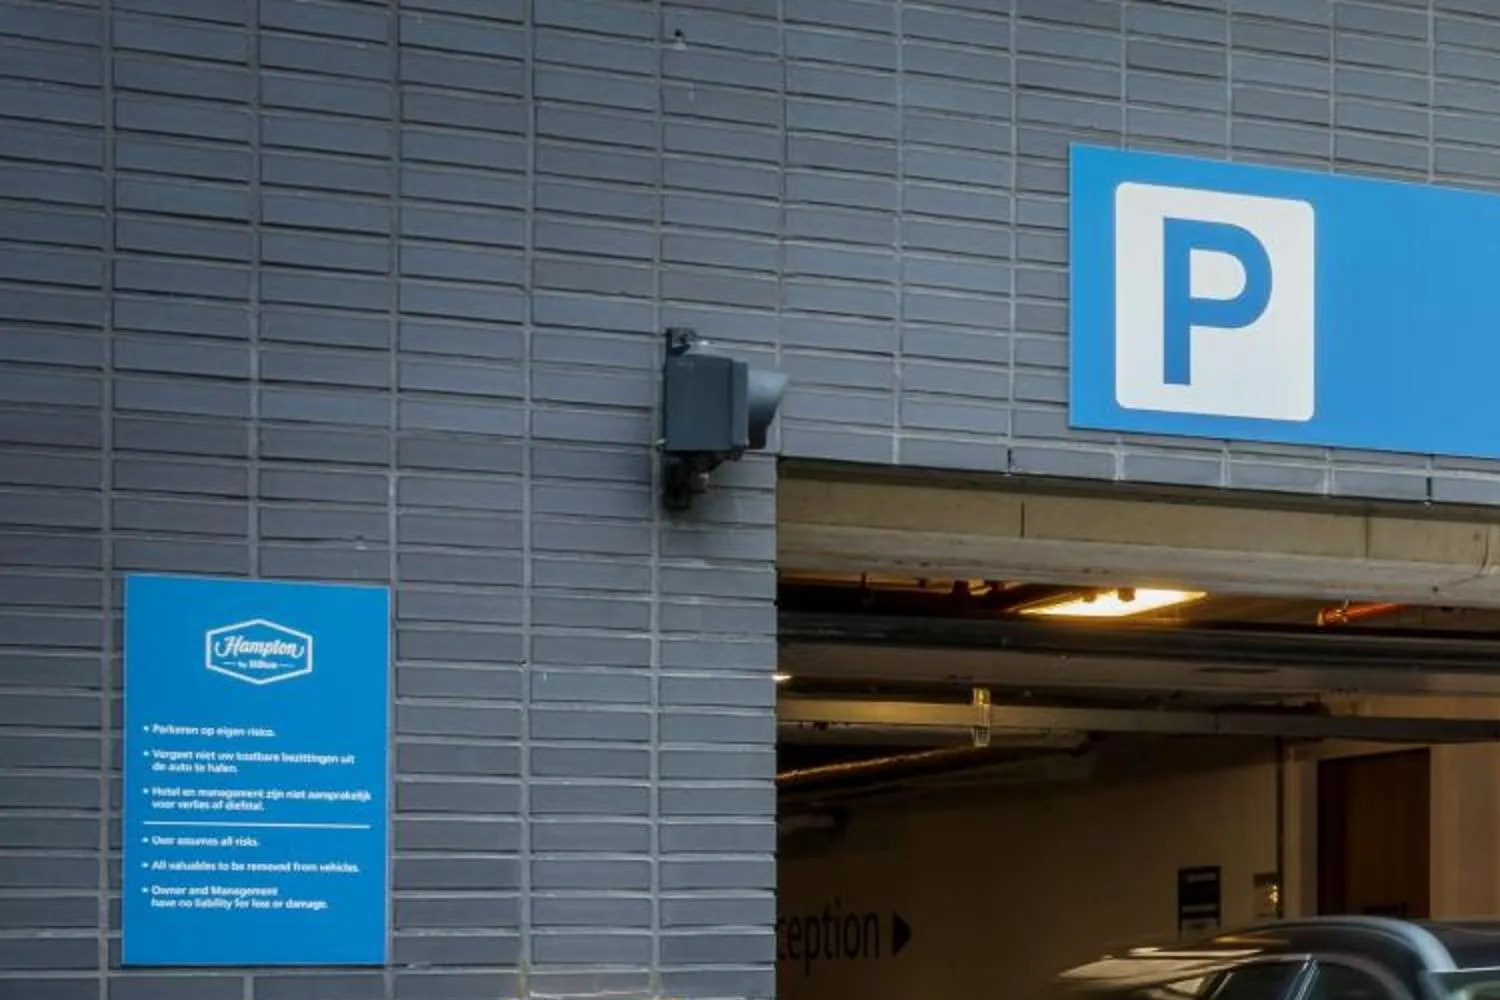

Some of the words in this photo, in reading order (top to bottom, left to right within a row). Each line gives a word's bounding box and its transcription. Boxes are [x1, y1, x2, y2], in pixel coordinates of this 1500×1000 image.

[1163, 216, 1273, 385] P
[215, 635, 305, 659] Hampton
[152, 723, 198, 735] Parkeren
[200, 727, 214, 737] op
[216, 726, 244, 738] eigen
[195, 750, 216, 761] niet
[220, 836, 233, 847] all
[152, 860, 166, 870] All
[218, 861, 229, 871] to
[231, 860, 245, 871] be
[247, 862, 291, 872] removed
[293, 861, 318, 872] from
[151, 885, 185, 896] Owner
[187, 886, 209, 896] and
[178, 899, 193, 908] no
[234, 897, 249, 909] for
